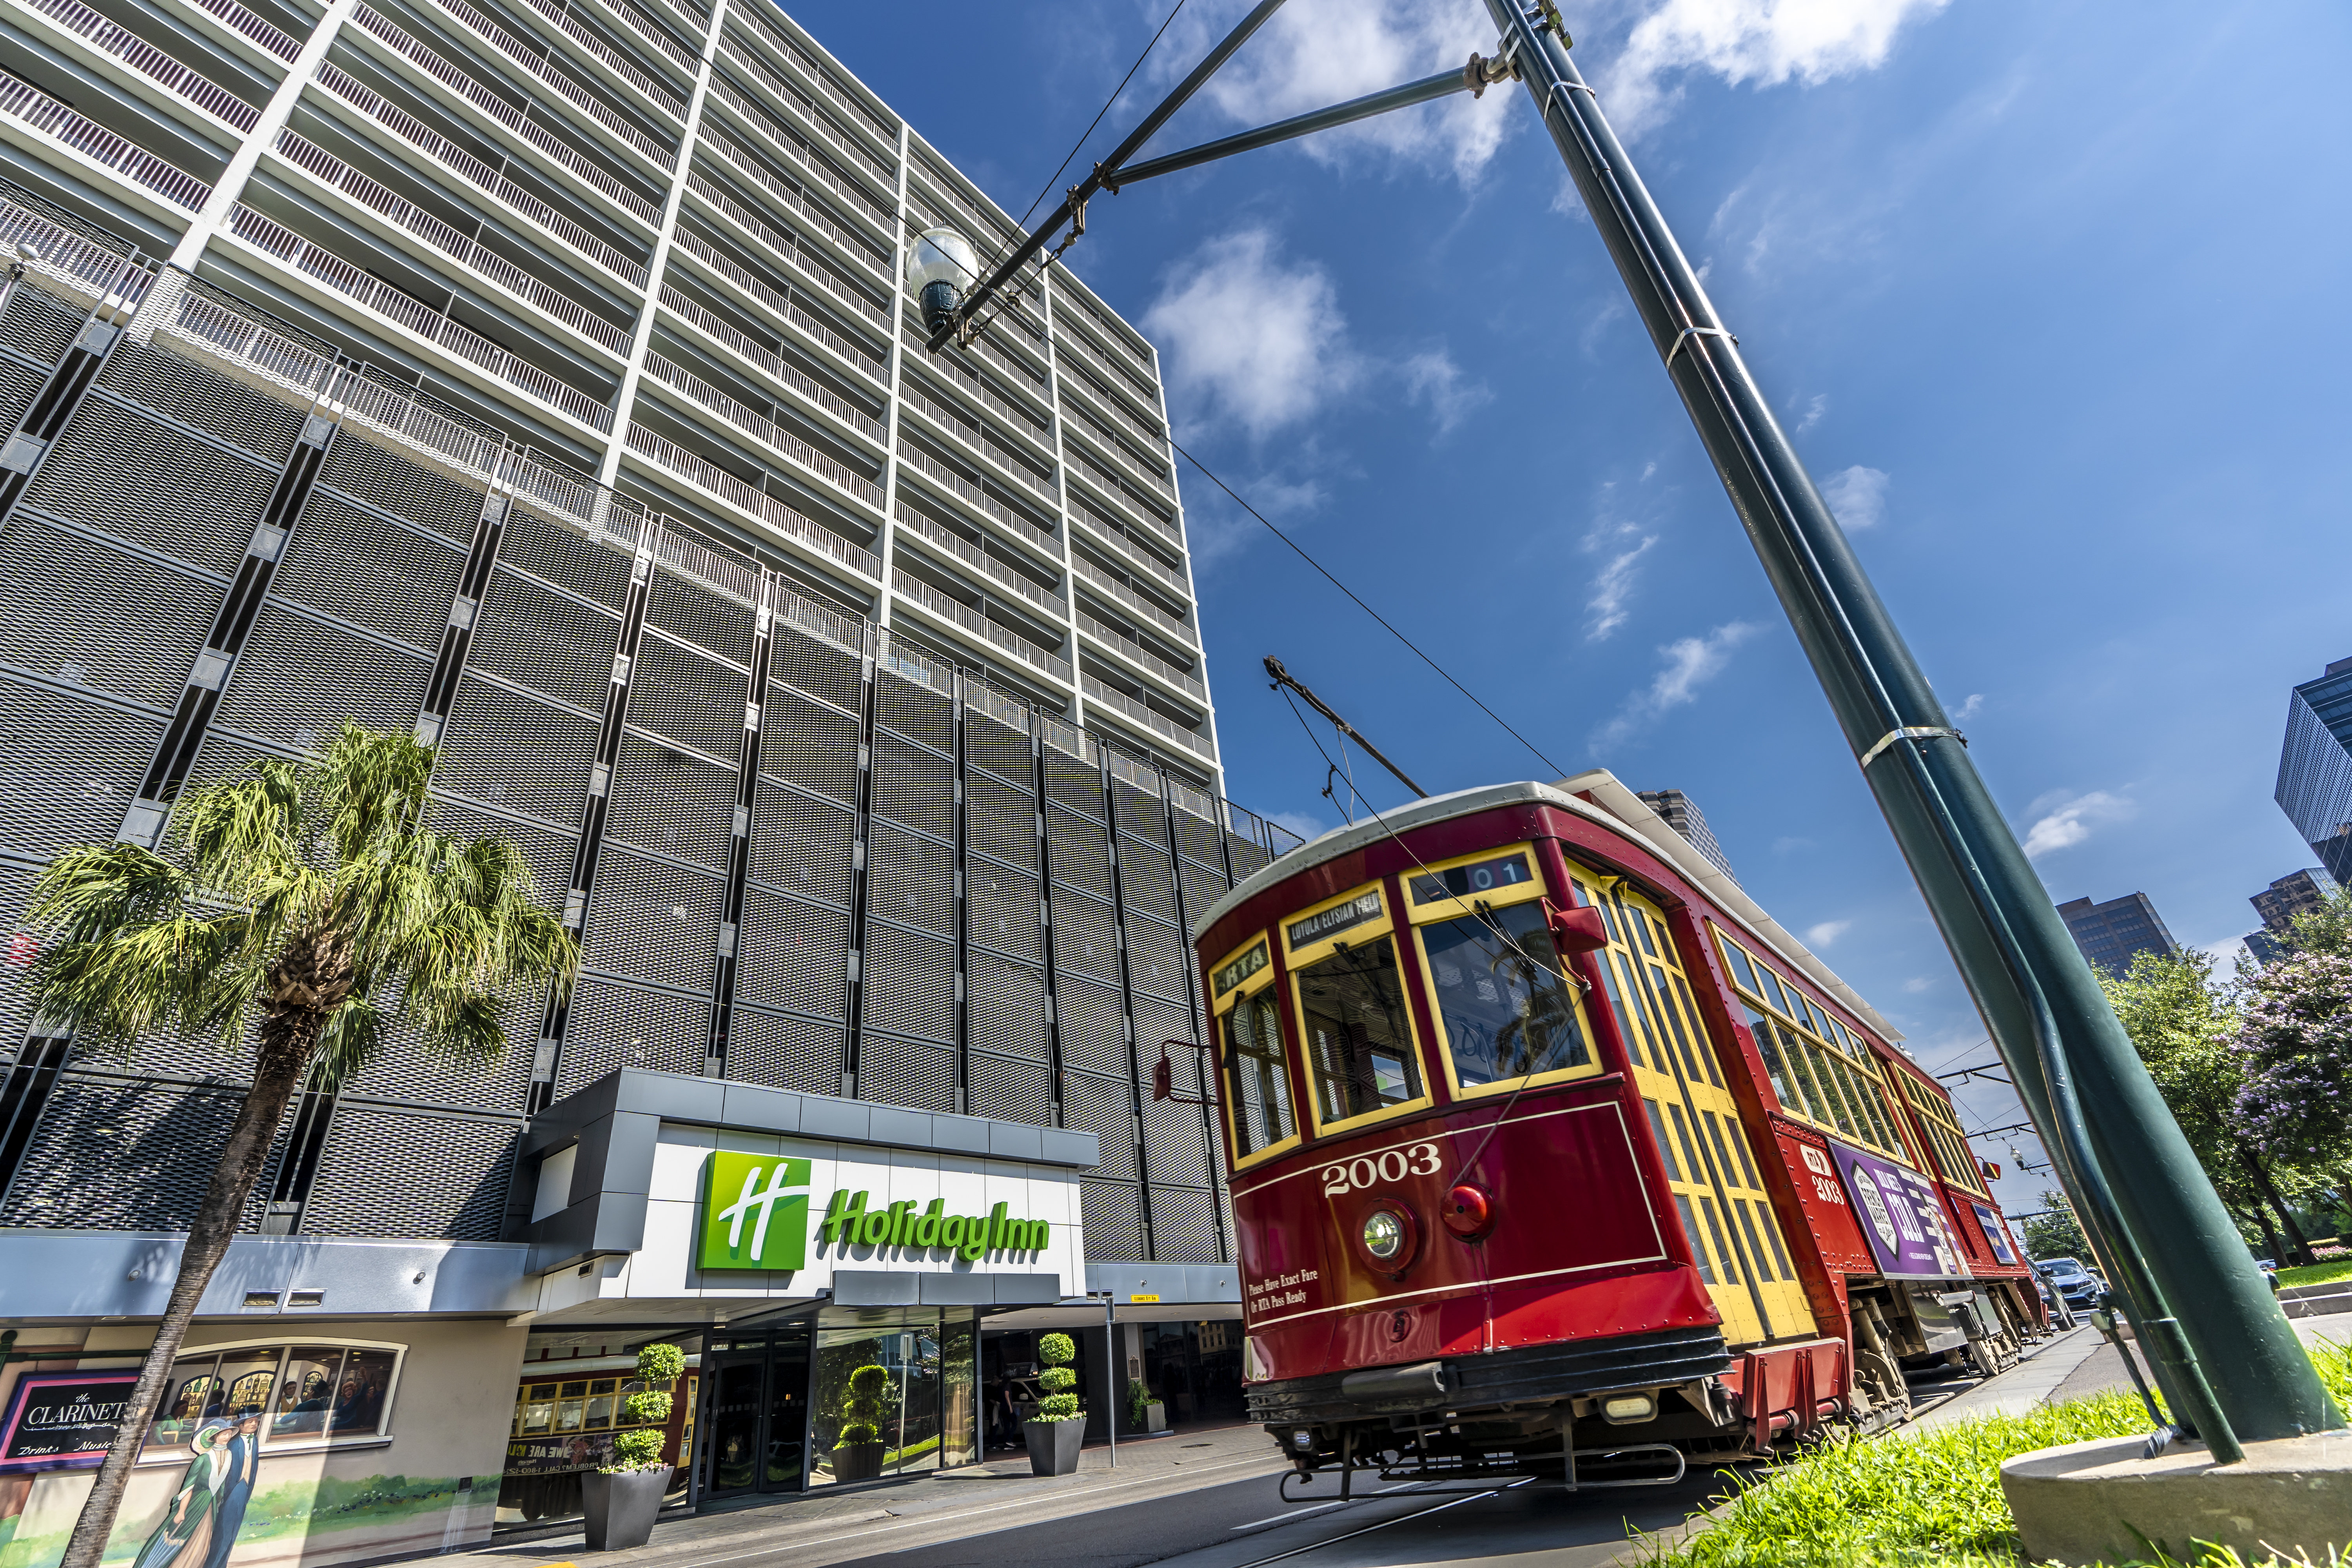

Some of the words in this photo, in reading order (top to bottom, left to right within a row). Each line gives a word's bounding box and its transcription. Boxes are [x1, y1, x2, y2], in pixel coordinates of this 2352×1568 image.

[1225, 947, 1265, 988] RTA
[1322, 1143, 1442, 1198] 2003
[1806, 1151, 1820, 1169] RTA
[1812, 1175, 1844, 1205] 2003
[1873, 1168, 1891, 1189] BOLD
[1885, 1172, 1904, 1193] MEETS
[1860, 1187, 1883, 1208] FRENCH
[1869, 1206, 1891, 1225] MARKET
[1885, 1192, 1925, 1243] COLD
[1249, 1284, 1264, 1296] Please
[1264, 1279, 1279, 1291] Have
[1280, 1273, 1300, 1287] Exact
[1300, 1269, 1318, 1281] Fare
[1250, 1301, 1258, 1313] Or
[1258, 1298, 1271, 1311] RTA
[1270, 1296, 1285, 1307] Pass
[1285, 1289, 1307, 1304] Ready
[76, 1393, 90, 1403] the
[28, 1402, 128, 1425] CLARINET
[18, 1445, 59, 1455] Drinks
[73, 1441, 112, 1451] Music
